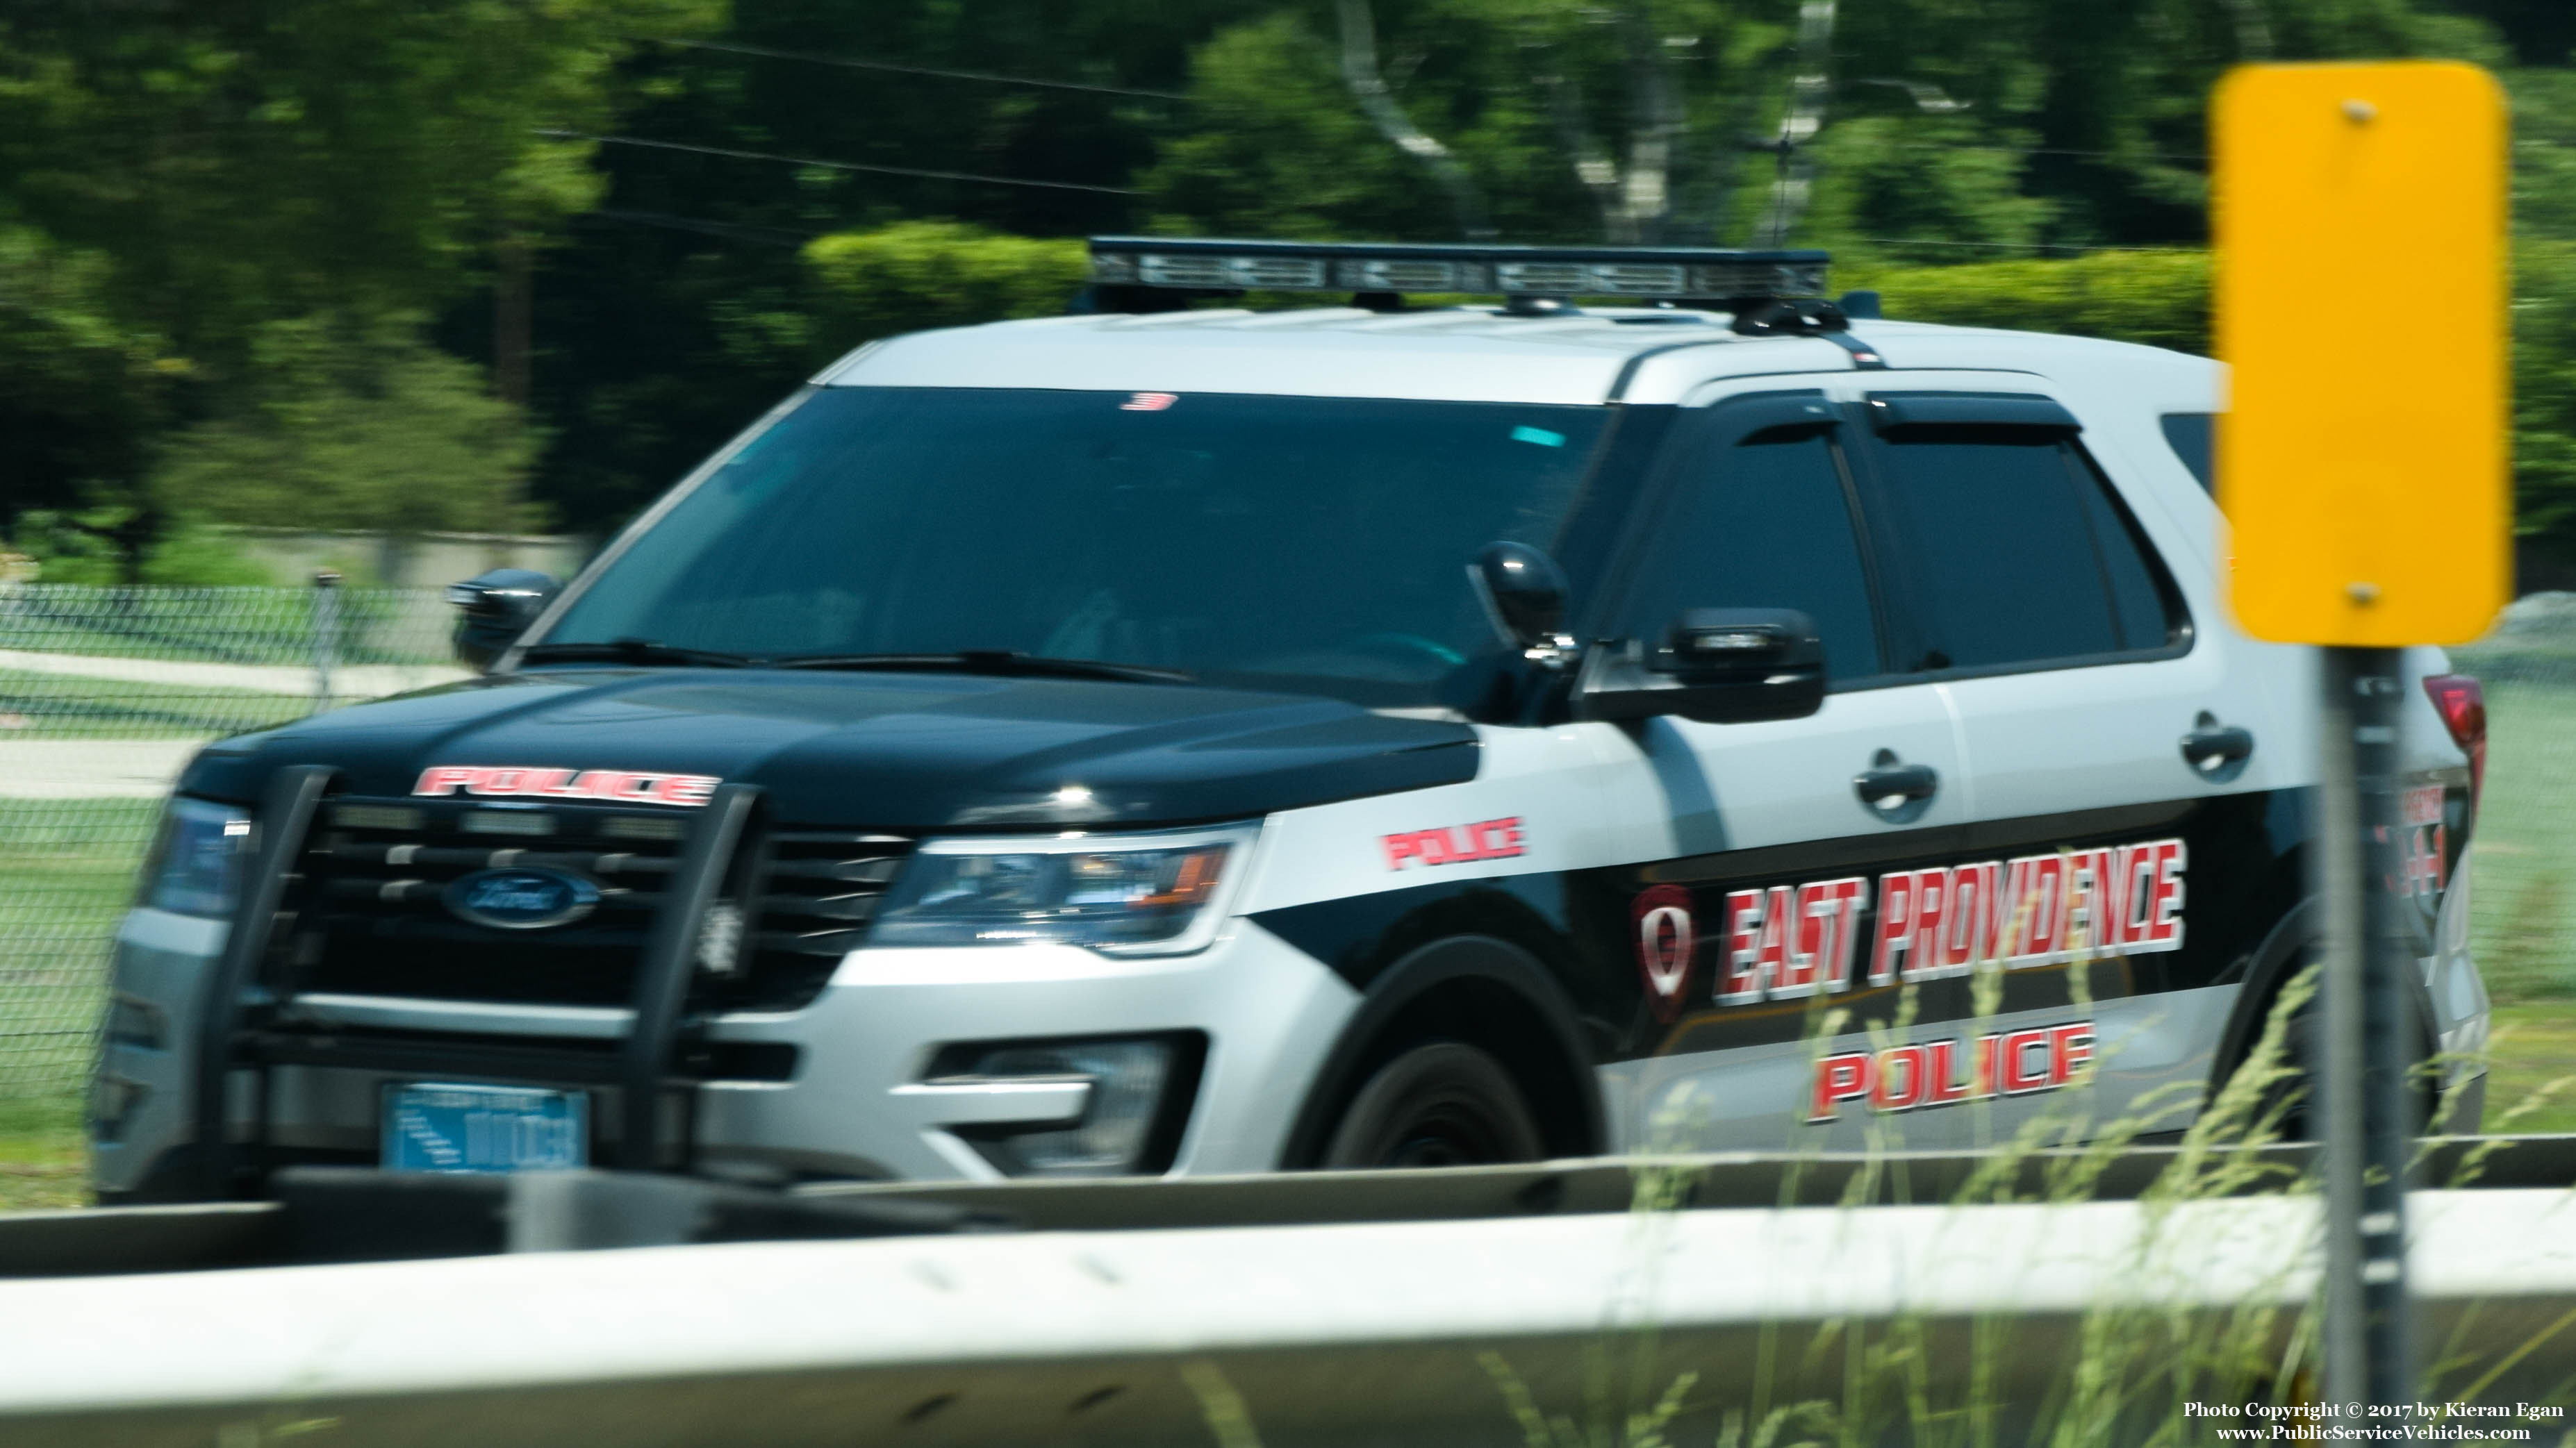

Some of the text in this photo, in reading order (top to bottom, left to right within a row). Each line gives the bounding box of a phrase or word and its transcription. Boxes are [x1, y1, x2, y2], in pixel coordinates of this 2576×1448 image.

[411, 765, 723, 806] POLICE
[1378, 817, 1531, 872] POLICE
[1714, 838, 2188, 1006] EAST PROVIDENCE
[1803, 1021, 2097, 1125] POLICE
